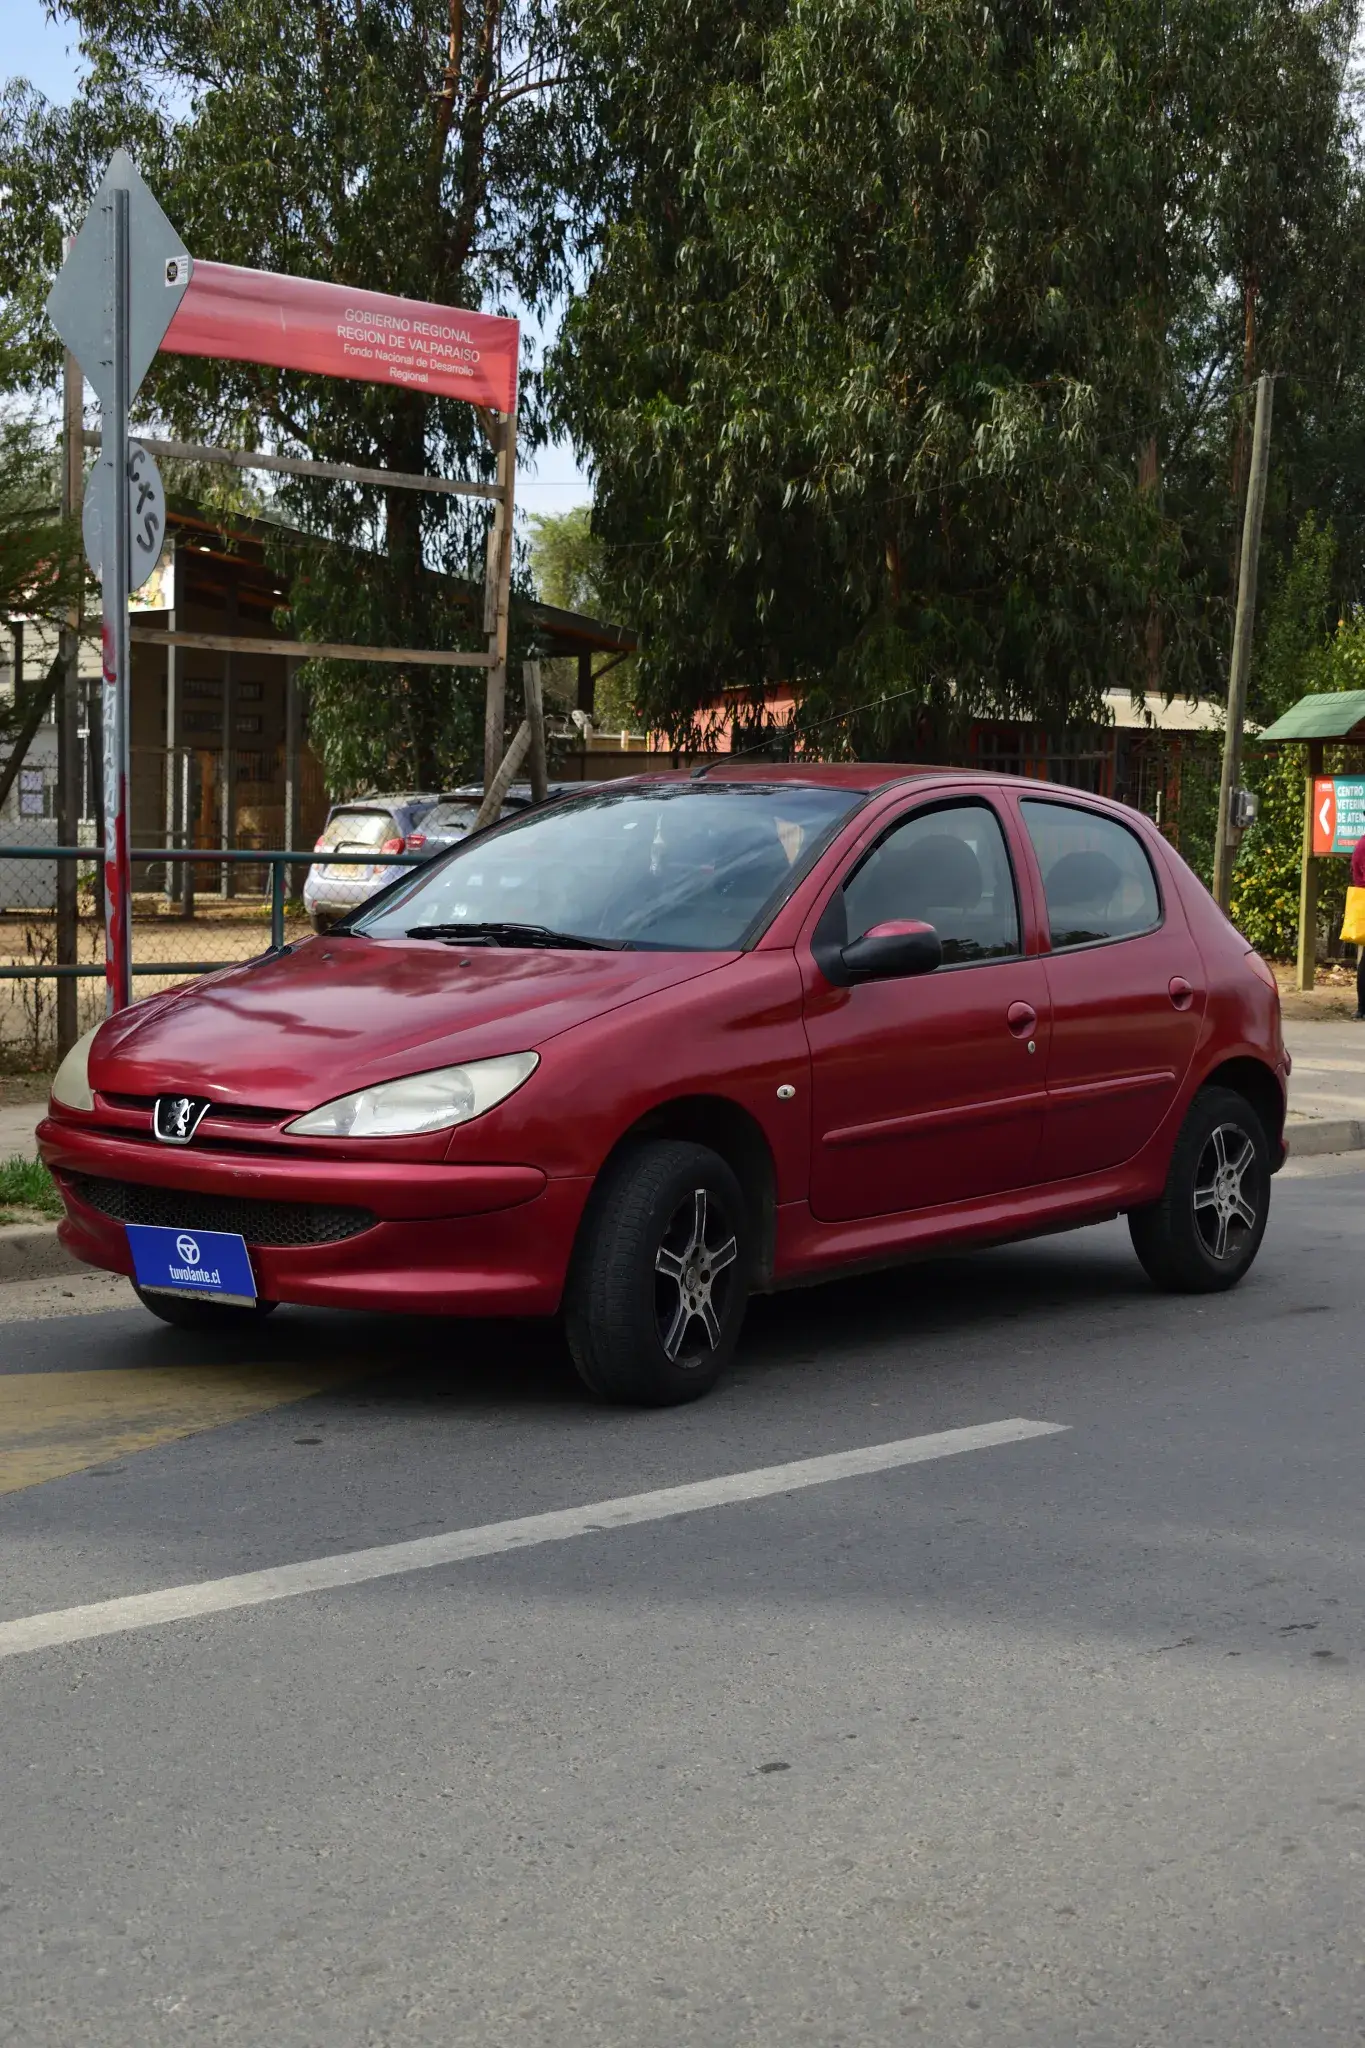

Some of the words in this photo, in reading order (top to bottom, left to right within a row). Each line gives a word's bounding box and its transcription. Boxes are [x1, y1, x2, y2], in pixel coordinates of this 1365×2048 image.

[345, 308, 410, 332] GOBIERNO
[413, 321, 475, 344] REGIONAL
[337, 325, 386, 345] REGION
[388, 334, 405, 349] DE
[408, 338, 480, 363] VALPARAISO
[343, 343, 373, 358] Fondo
[375, 351, 414, 366] Nacional
[416, 356, 428, 368] de
[430, 359, 474, 377] Desarrollo
[389, 367, 429, 383] Regional
[1337, 785, 1364, 797] CENTRO
[1337, 799, 1365, 810] VETERIN
[1337, 812, 1347, 823] DE
[1347, 812, 1365, 823] ATEN
[169, 1264, 222, 1284] tuvolante.cl
